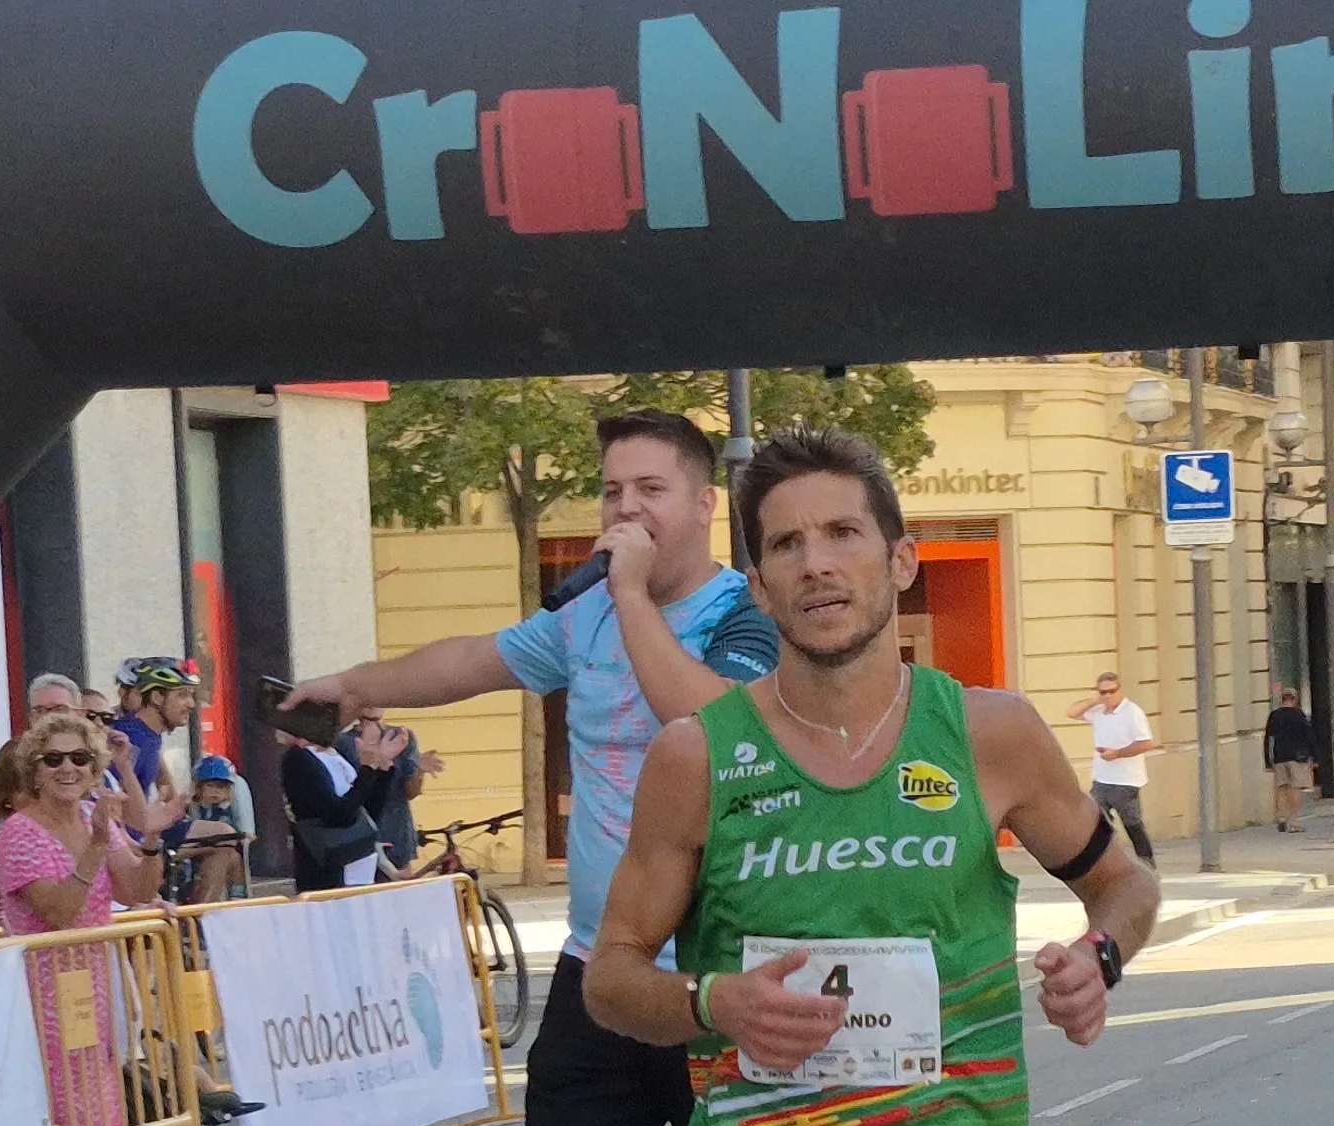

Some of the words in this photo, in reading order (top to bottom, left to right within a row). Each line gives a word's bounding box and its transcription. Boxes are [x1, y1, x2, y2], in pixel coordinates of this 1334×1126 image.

[737, 834, 957, 881] Huesca
[821, 964, 854, 1000] 4
[843, 1013, 892, 1029] ANDO
